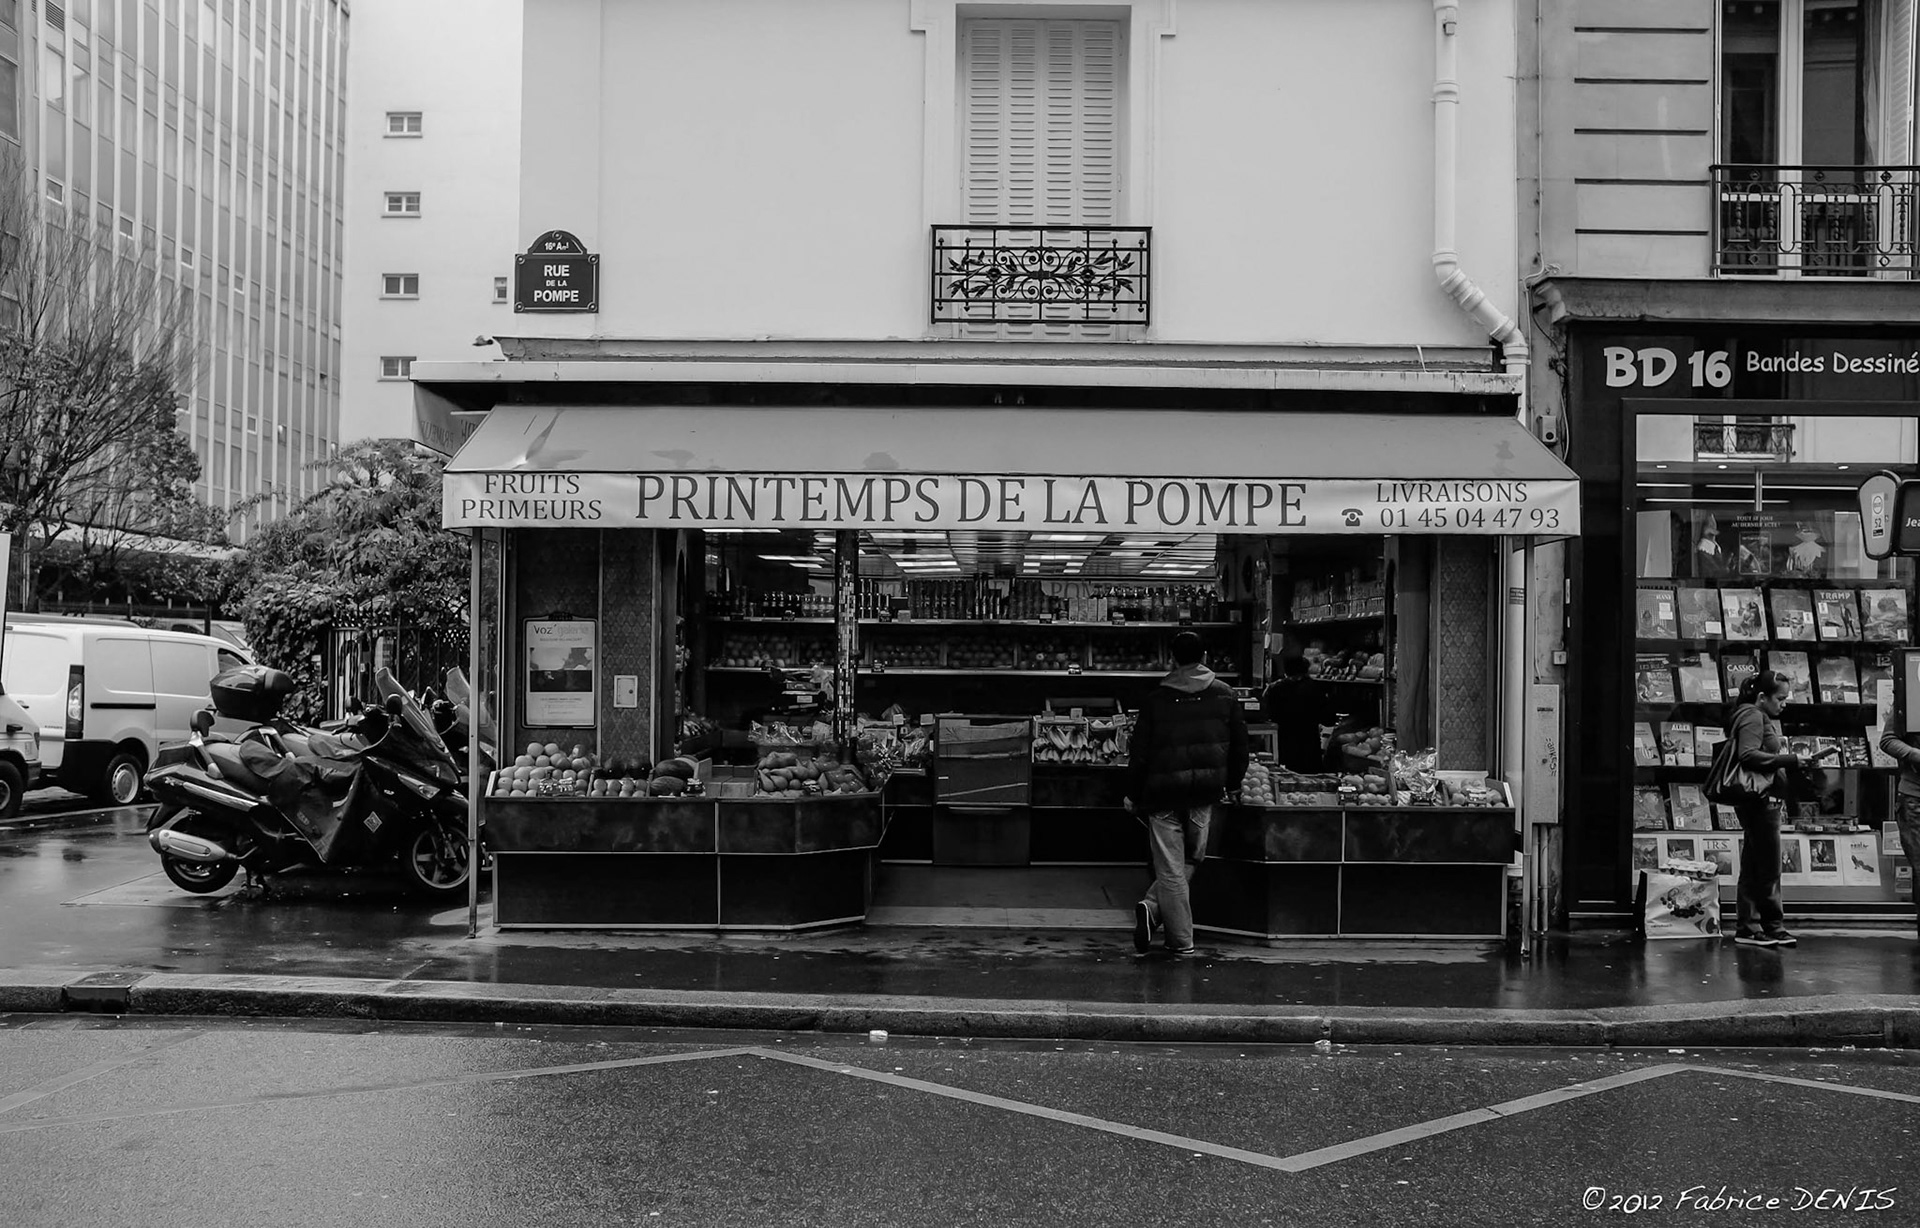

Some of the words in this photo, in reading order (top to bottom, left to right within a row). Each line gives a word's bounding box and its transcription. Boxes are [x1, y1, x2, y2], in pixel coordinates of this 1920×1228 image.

[544, 264, 570, 277] RUE
[533, 290, 579, 302] POMPE
[1603, 346, 1677, 387] BD
[1688, 350, 1732, 387] 16
[1746, 351, 1825, 373] Bandes
[484, 475, 580, 495] FRUITS
[1376, 482, 1528, 503] LIVRAISONS
[461, 499, 602, 520] PRIMEURS
[636, 475, 940, 522] PRINTEMPS
[957, 478, 1025, 522] DE
[1043, 479, 1108, 524] LA
[1124, 480, 1307, 526] POMPE
[1380, 508, 1409, 528] 01
[1417, 508, 1448, 528] 45
[1456, 508, 1485, 528] 04
[1492, 508, 1522, 528] 47
[1530, 508, 1560, 529] 93
[1820, 592, 1851, 600] TRAMP
[1727, 664, 1755, 672] CASSIO
